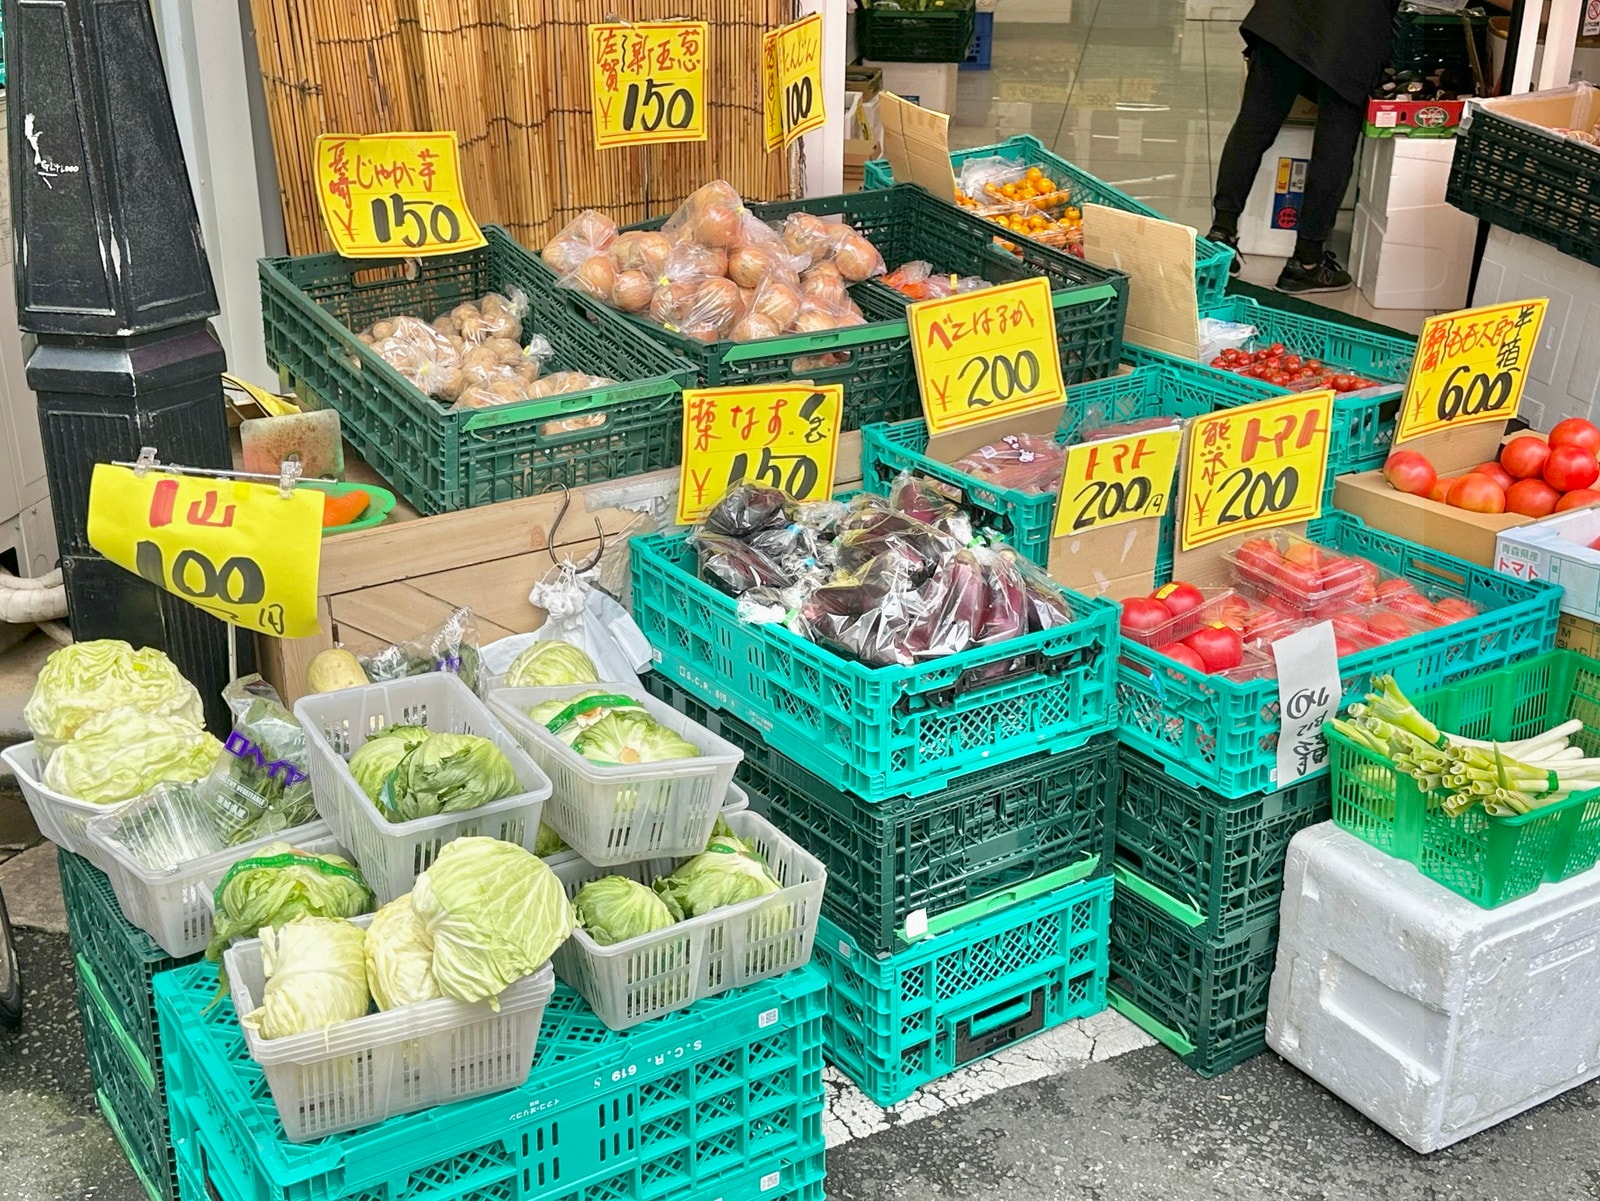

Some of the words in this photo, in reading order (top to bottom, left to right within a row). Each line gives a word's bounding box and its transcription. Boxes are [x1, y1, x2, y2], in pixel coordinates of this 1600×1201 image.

[623, 78, 694, 131] 150
[786, 76, 812, 134] 100
[328, 141, 356, 209] 長崎
[356, 148, 439, 192] じゃが芋
[371, 193, 461, 248] 150
[958, 350, 1040, 408] 200
[1437, 366, 1515, 421] 600
[1085, 438, 1156, 481] トマト
[1240, 408, 1328, 463] トマト
[149, 480, 236, 528] 1山
[1216, 466, 1300, 525] 200
[1499, 557, 1539, 580] トマト
[611, 1063, 637, 1083] 619
[647, 1040, 702, 1066] S.C.R.
